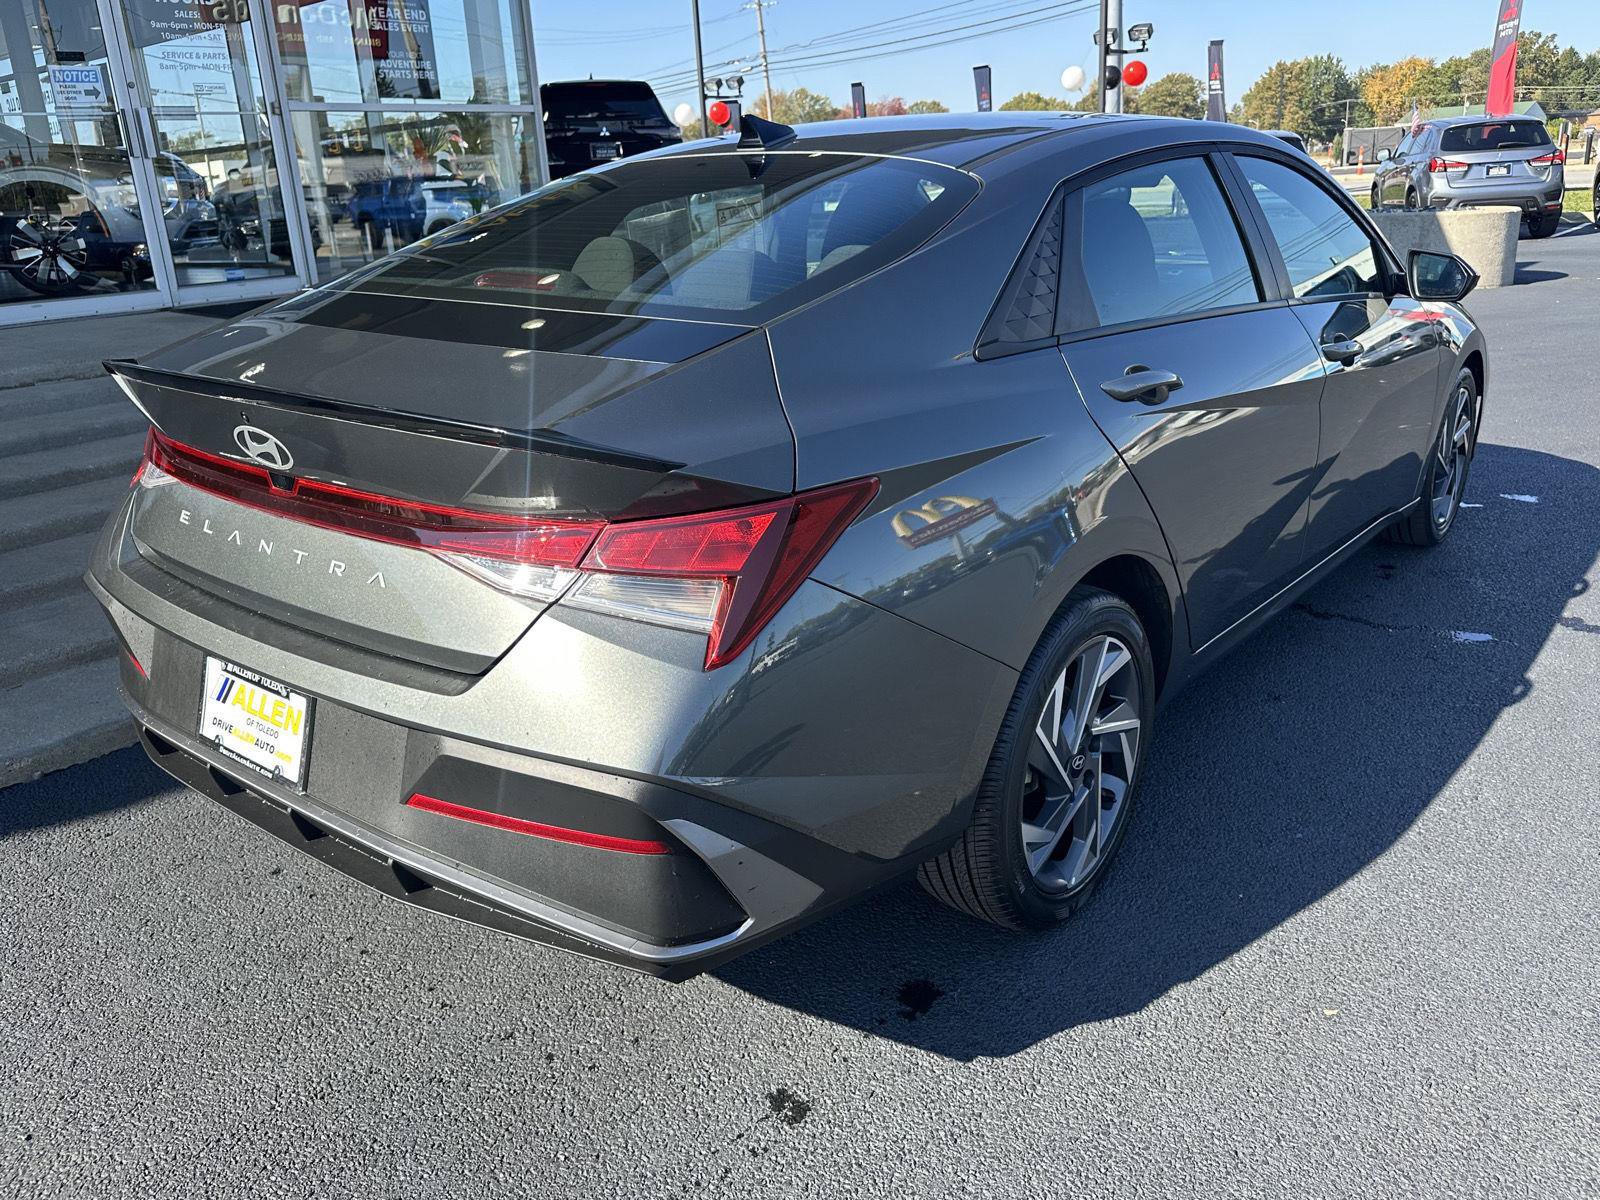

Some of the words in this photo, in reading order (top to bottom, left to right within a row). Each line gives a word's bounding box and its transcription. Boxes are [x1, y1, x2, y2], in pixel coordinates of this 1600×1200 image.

[174, 10, 201, 18] SALES:
[370, 7, 400, 19] YEAR
[404, 10, 427, 20] END
[150, 21, 188, 30] 9am-6pm
[371, 22, 399, 31] SALES
[401, 24, 429, 33] EVENT
[380, 60, 431, 69] ADVENTURE
[54, 70, 97, 82] NOTICE
[378, 70, 412, 79] STARTS
[413, 71, 436, 80] HERE
[179, 509, 386, 588] ELANTRA
[231, 683, 303, 736] ALLEN
[246, 717, 255, 727] OF
[255, 722, 279, 739] TOLEDO
